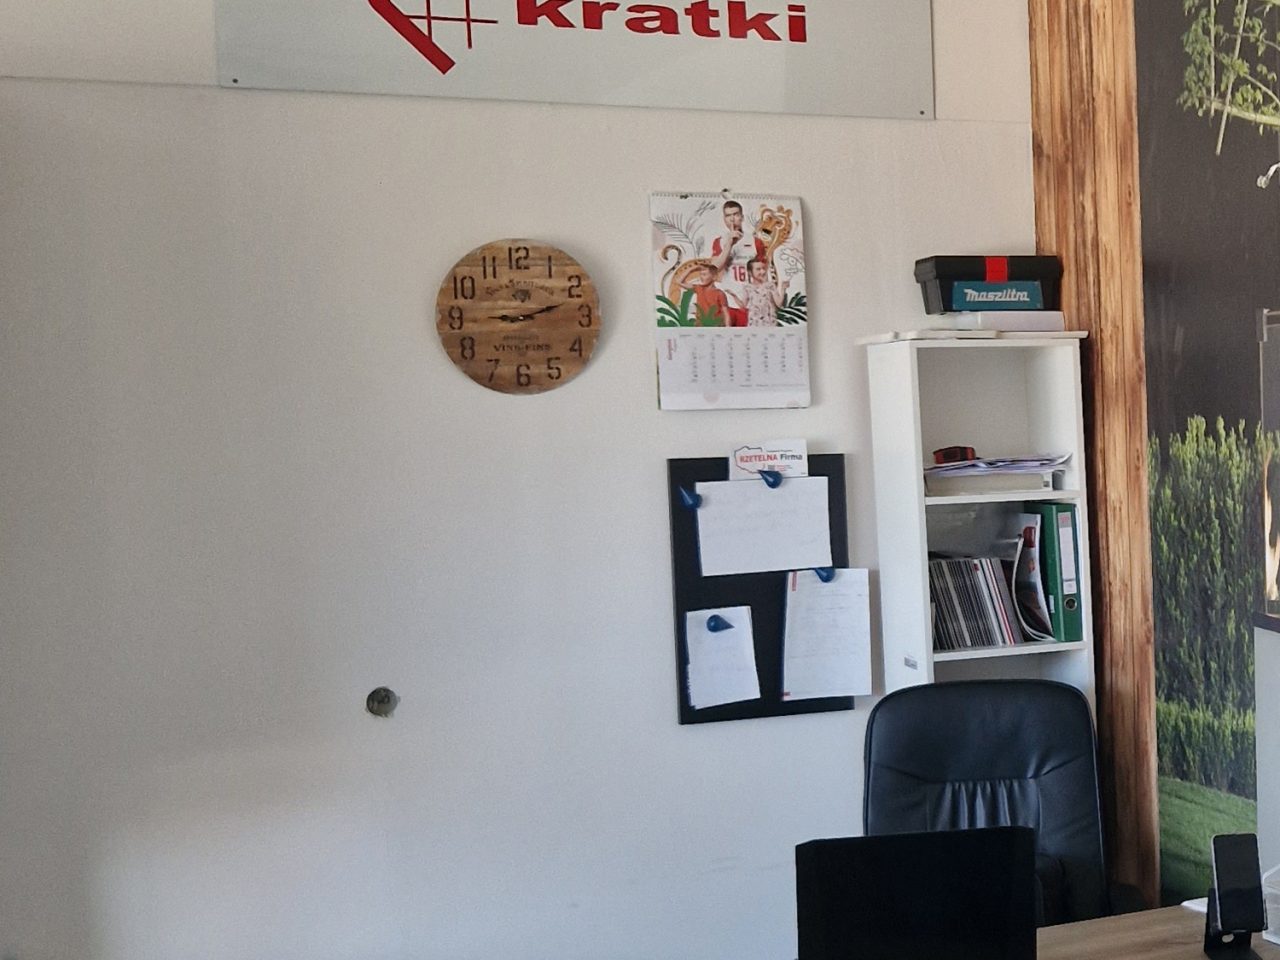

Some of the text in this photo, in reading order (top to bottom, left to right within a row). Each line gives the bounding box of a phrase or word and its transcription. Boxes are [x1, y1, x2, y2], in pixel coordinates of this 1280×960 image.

[516, 0, 808, 43] kratki
[482, 256, 497, 280] 11
[507, 246, 531, 270] 12
[547, 255, 553, 279] 1
[453, 275, 476, 300] 10
[567, 275, 582, 299] 2
[448, 305, 464, 331] 9
[577, 304, 592, 328] 3
[460, 336, 476, 361] 8
[568, 336, 583, 358] 4
[486, 358, 500, 383] 7
[516, 363, 531, 387] 6
[546, 356, 562, 380] 5
[739, 452, 803, 464] RZETELNA Firma
